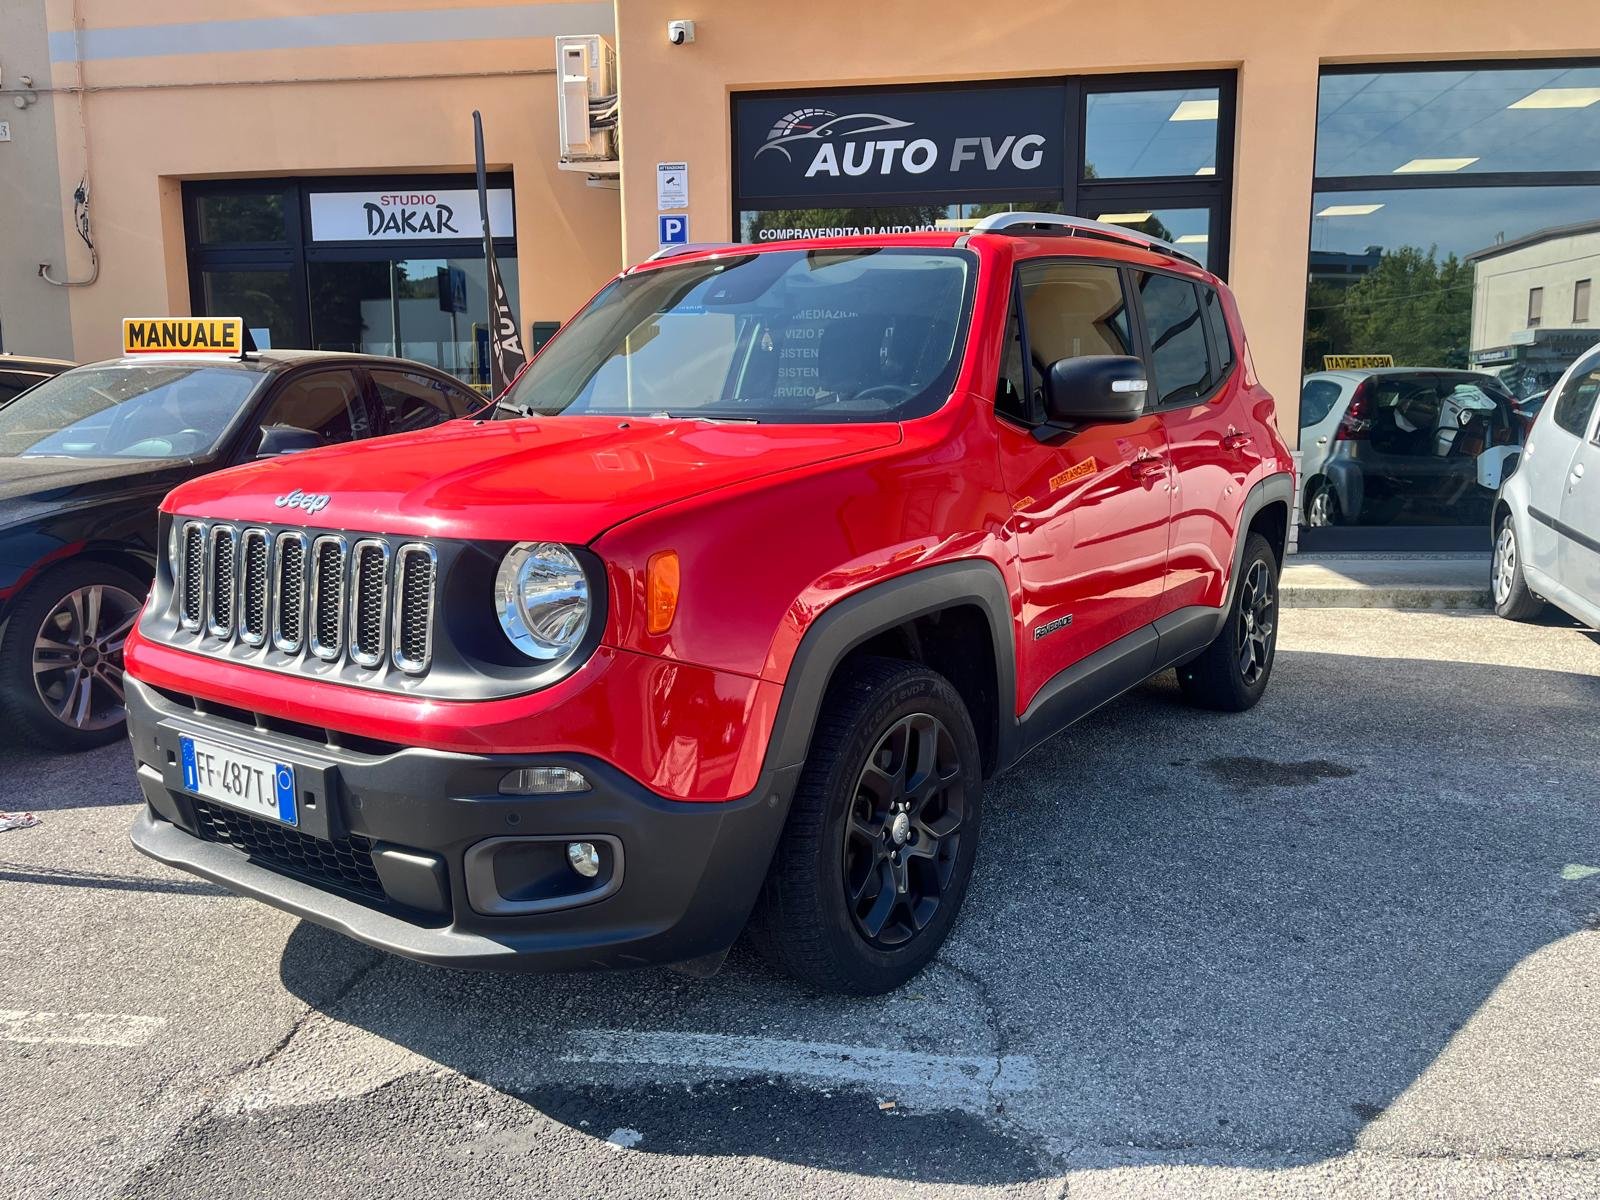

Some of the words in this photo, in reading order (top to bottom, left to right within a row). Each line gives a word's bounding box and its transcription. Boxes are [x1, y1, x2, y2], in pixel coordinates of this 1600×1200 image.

[805, 139, 938, 177] AUTO
[949, 134, 1046, 172] FVG
[380, 194, 436, 206] STUDIO
[363, 202, 459, 236] DAKAR
[665, 219, 682, 241] P
[759, 227, 860, 239] COMPRAVENDITA
[863, 226, 875, 235] DI
[879, 226, 912, 234] AUTO
[129, 322, 234, 347] MANUALE
[778, 367, 819, 377] SISTEN
[274, 488, 331, 515] Jeep
